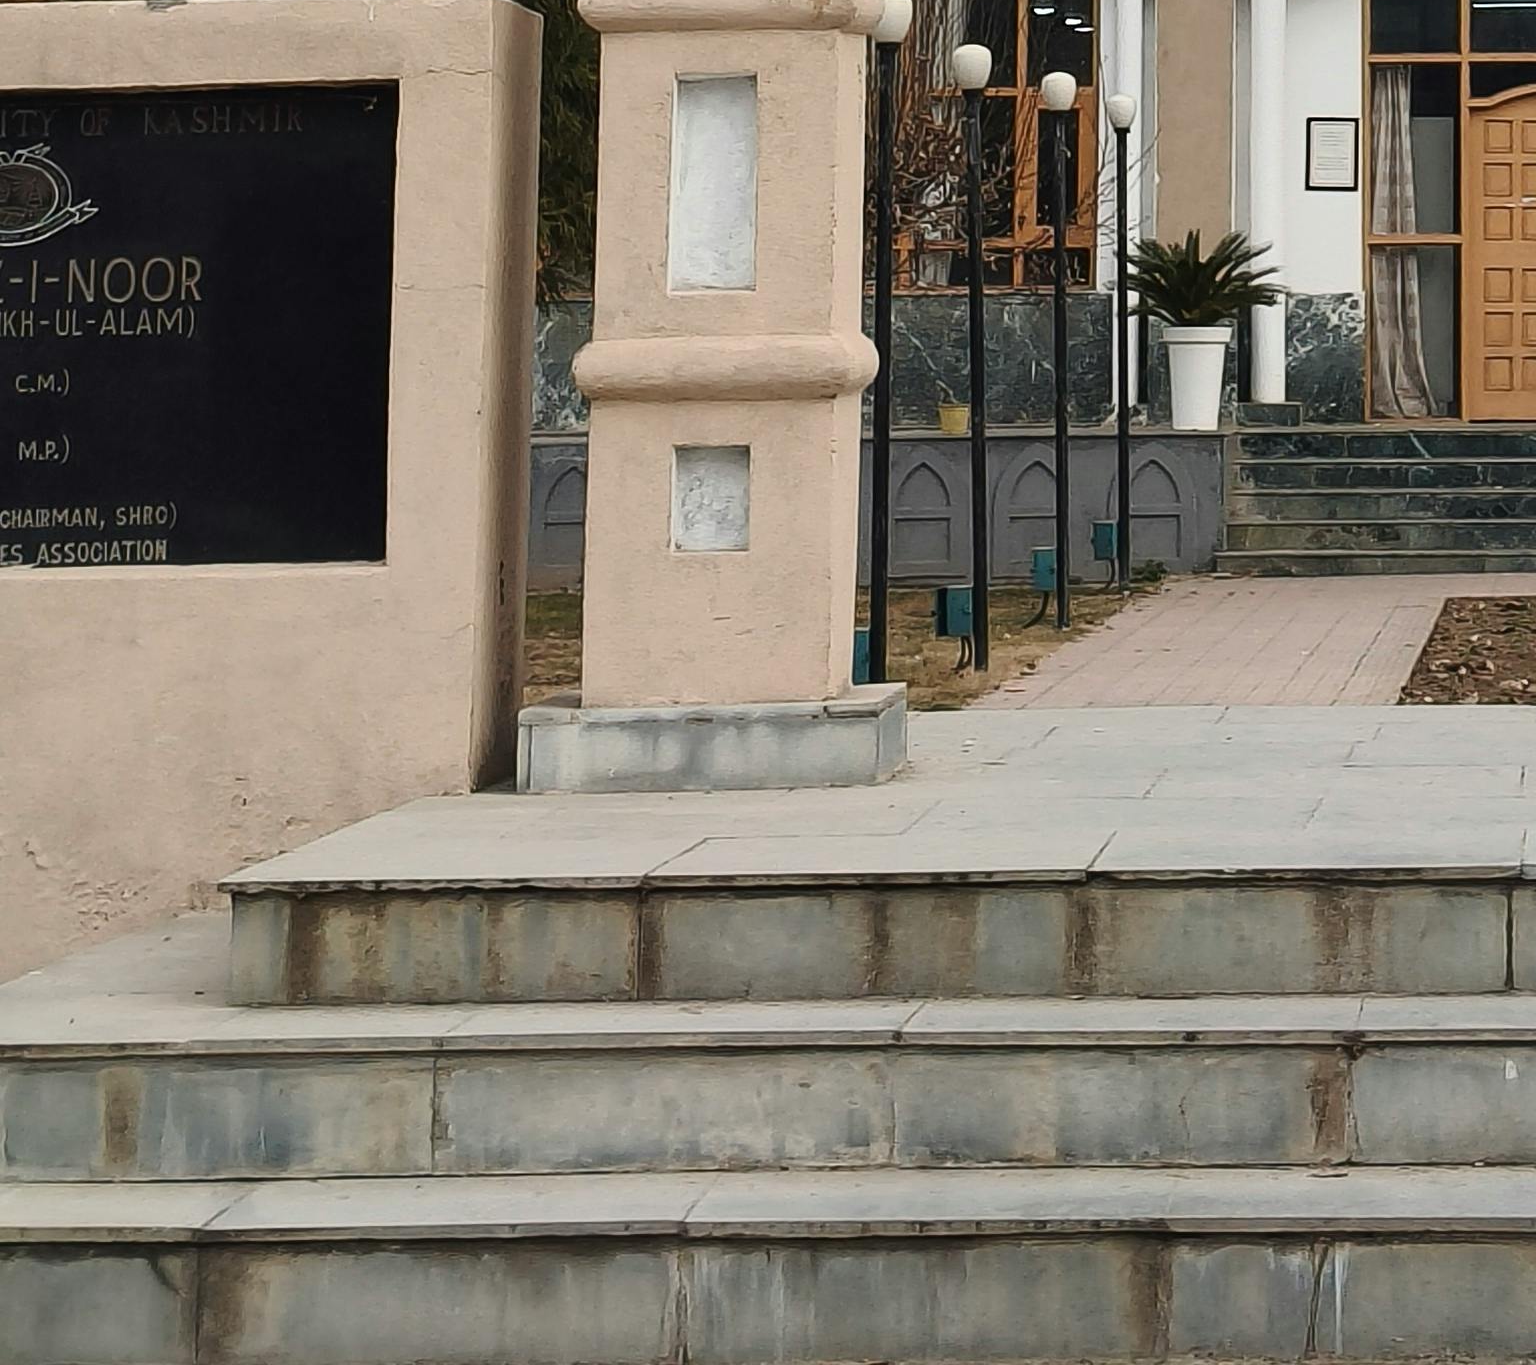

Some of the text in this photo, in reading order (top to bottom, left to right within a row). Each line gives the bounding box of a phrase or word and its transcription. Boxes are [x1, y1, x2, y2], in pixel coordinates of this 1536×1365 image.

[80, 108, 109, 136] OF
[144, 104, 303, 136] KASHMIR
[0, 255, 202, 303] -I-NOOR
[36, 539, 167, 564] ASSOCIATION
